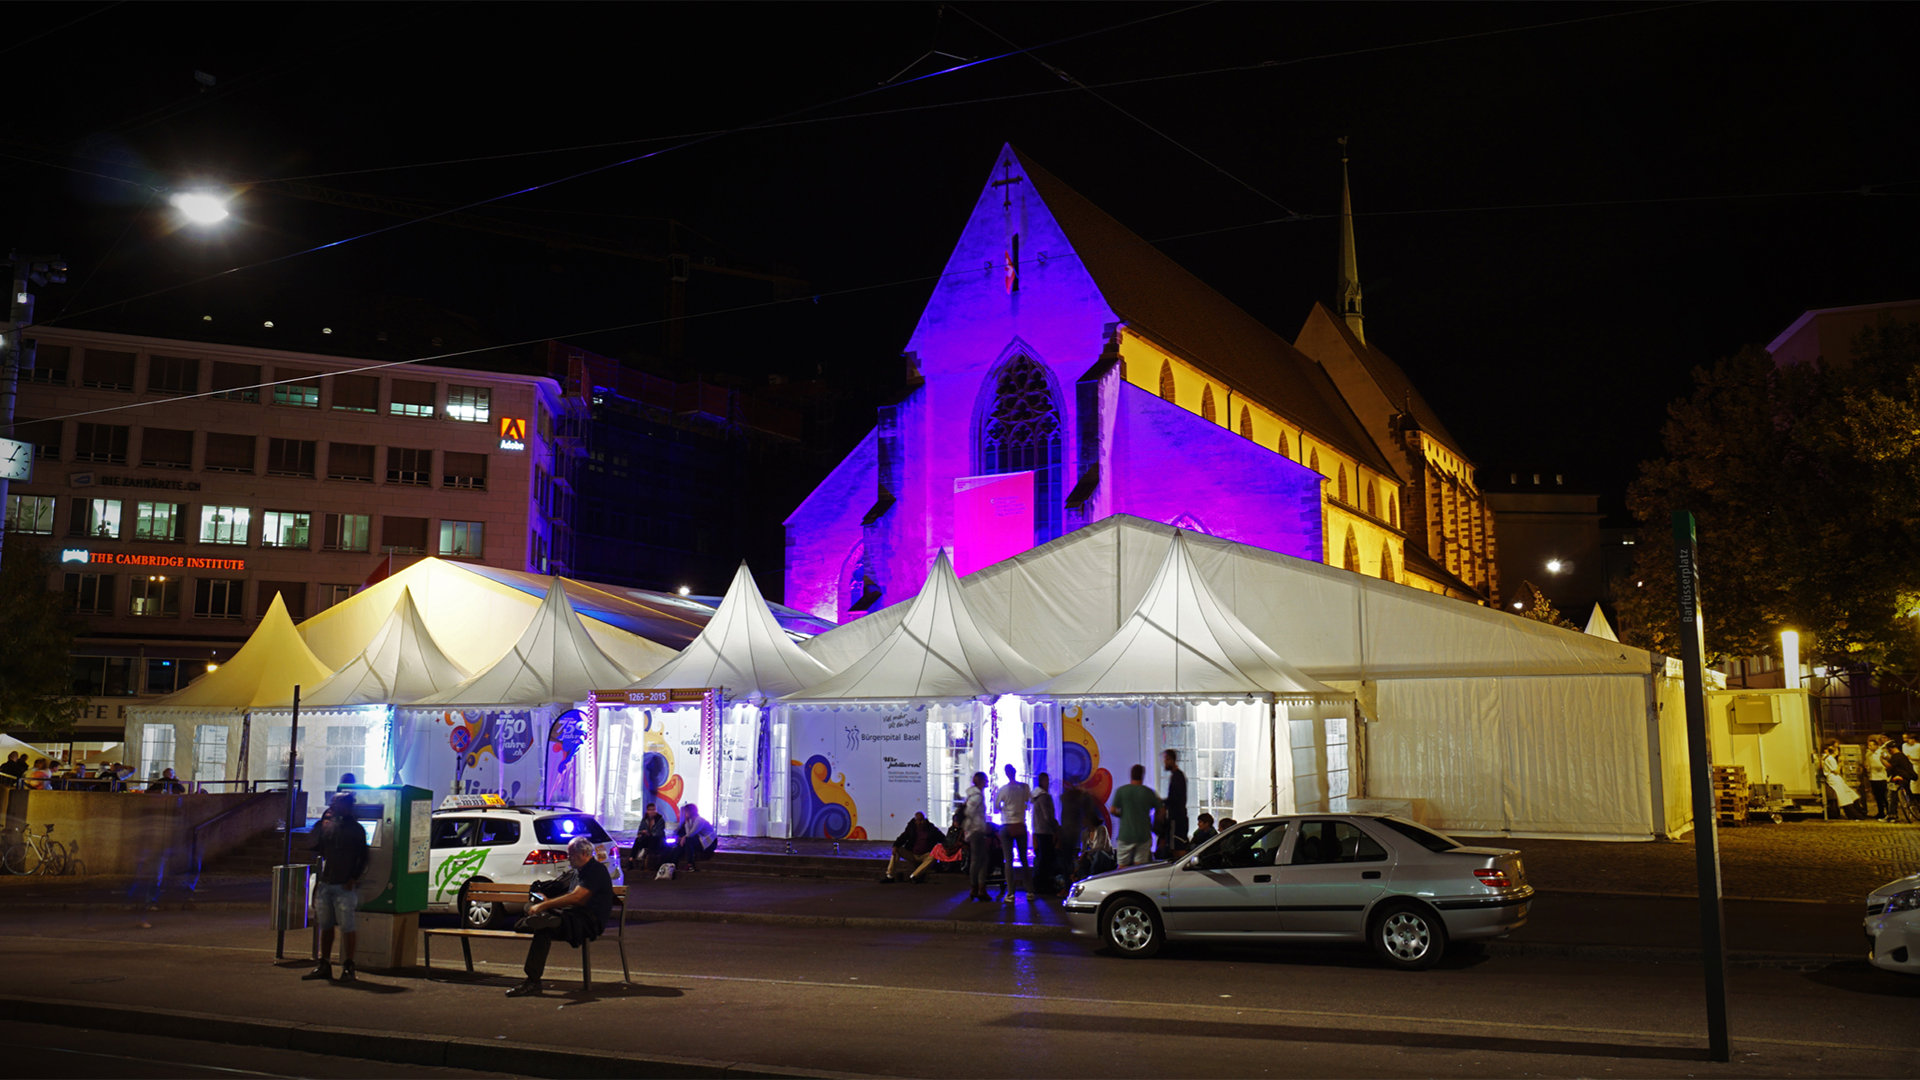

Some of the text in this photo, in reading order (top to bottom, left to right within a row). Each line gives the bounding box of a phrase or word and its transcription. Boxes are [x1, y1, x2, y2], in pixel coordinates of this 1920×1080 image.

[500, 439, 525, 451] Adobe
[101, 476, 201, 491] DIE ZAHNÄRZTE.CH
[89, 552, 245, 570] THE CAMBRIDGE INSTITUTE
[1679, 549, 1692, 622] Barfüsserplatz
[494, 718, 527, 740] 750
[556, 719, 588, 734] 750
[559, 732, 582, 741] jahr
[861, 733, 920, 742] Bürgerspital Basel
[501, 739, 526, 751] jahre
